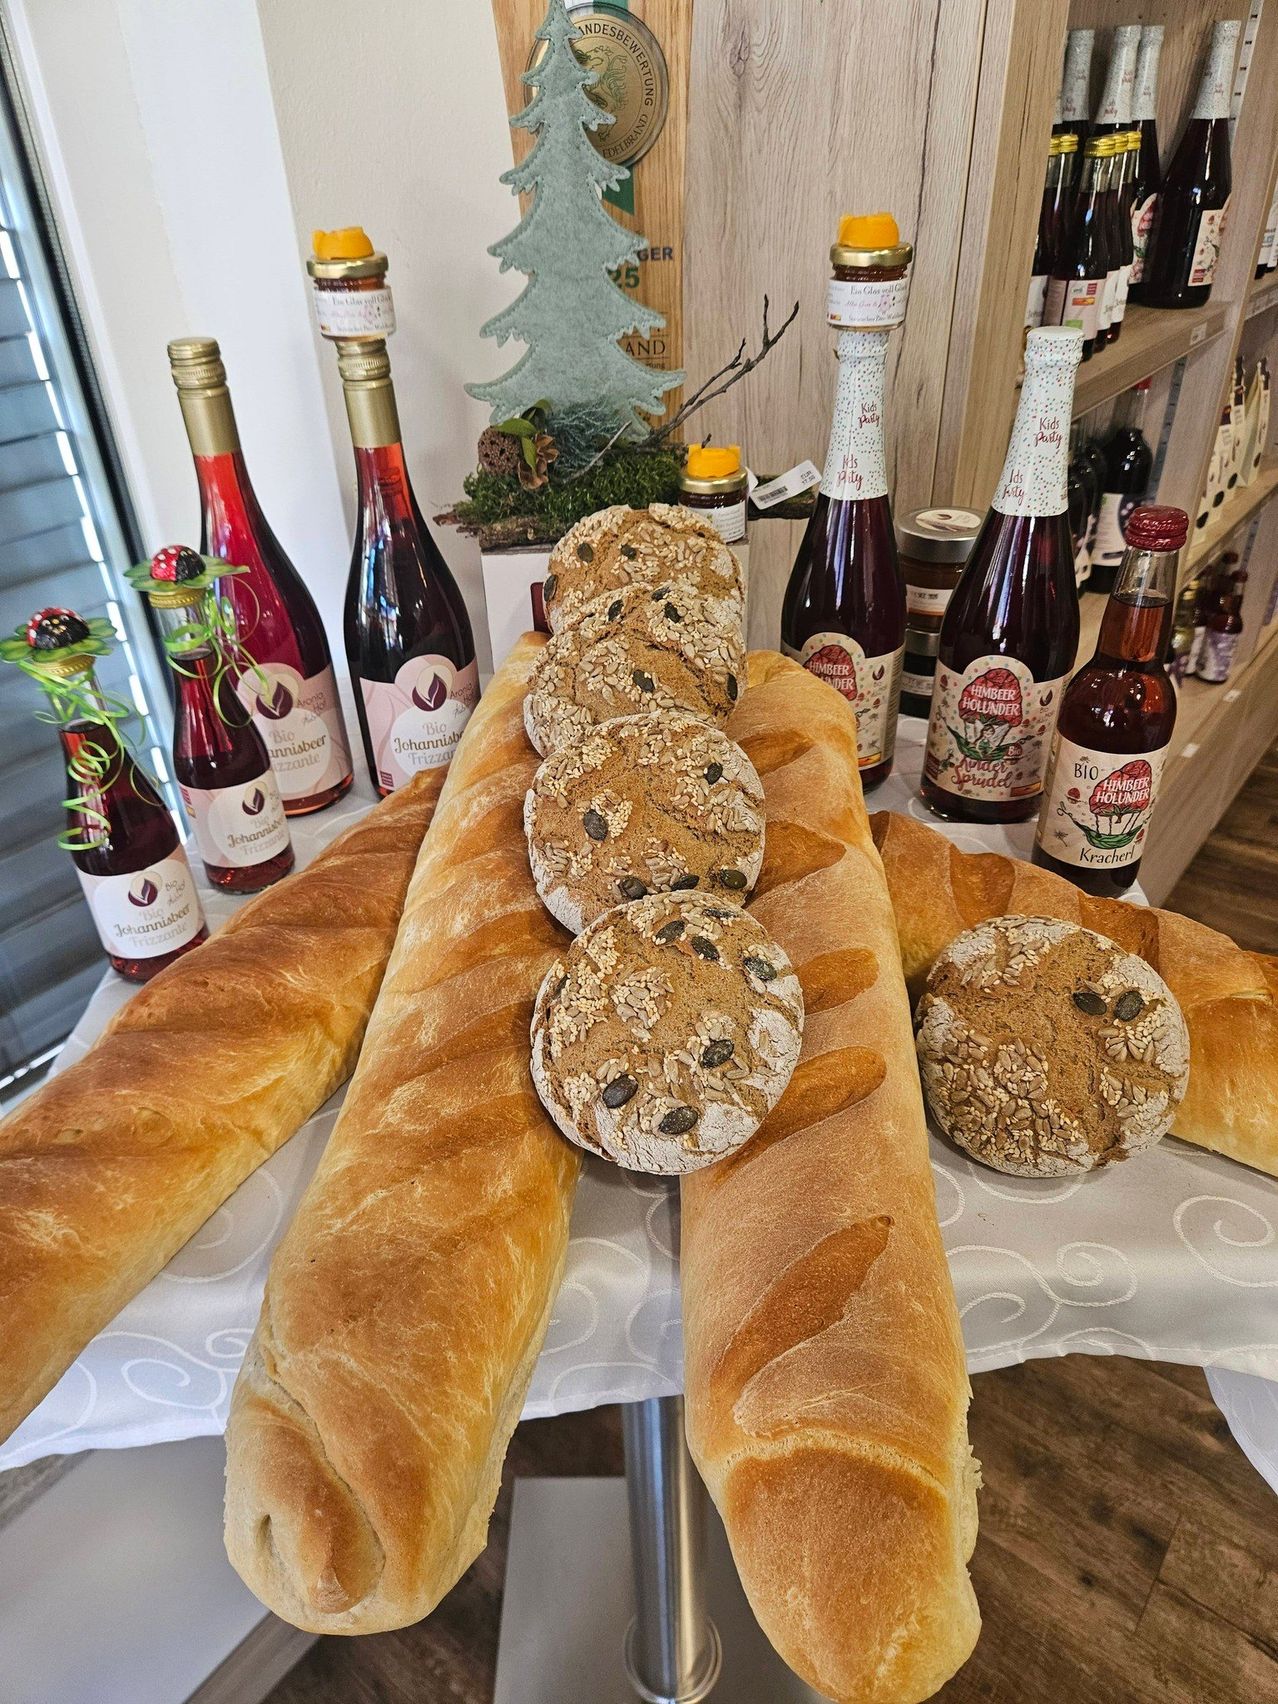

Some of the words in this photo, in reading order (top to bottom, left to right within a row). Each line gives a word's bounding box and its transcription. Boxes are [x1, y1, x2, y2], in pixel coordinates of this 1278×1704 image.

[578, 23, 654, 107] ANDESBEWERTUNG
[1040, 416, 1060, 430] Kids
[1033, 430, 1062, 450] Party
[809, 660, 850, 676] HIMBEER
[971, 684, 1017, 701] HIMBEER
[962, 696, 1021, 716] HOLUNDER
[268, 729, 296, 744] Bio
[422, 720, 447, 736] Bio
[951, 765, 1014, 791] Sprudel
[1074, 762, 1099, 780] BIO
[1103, 776, 1150, 792] HIMBEER
[1095, 788, 1150, 805] HOLUNDER
[1080, 845, 1135, 864] Kracherl
